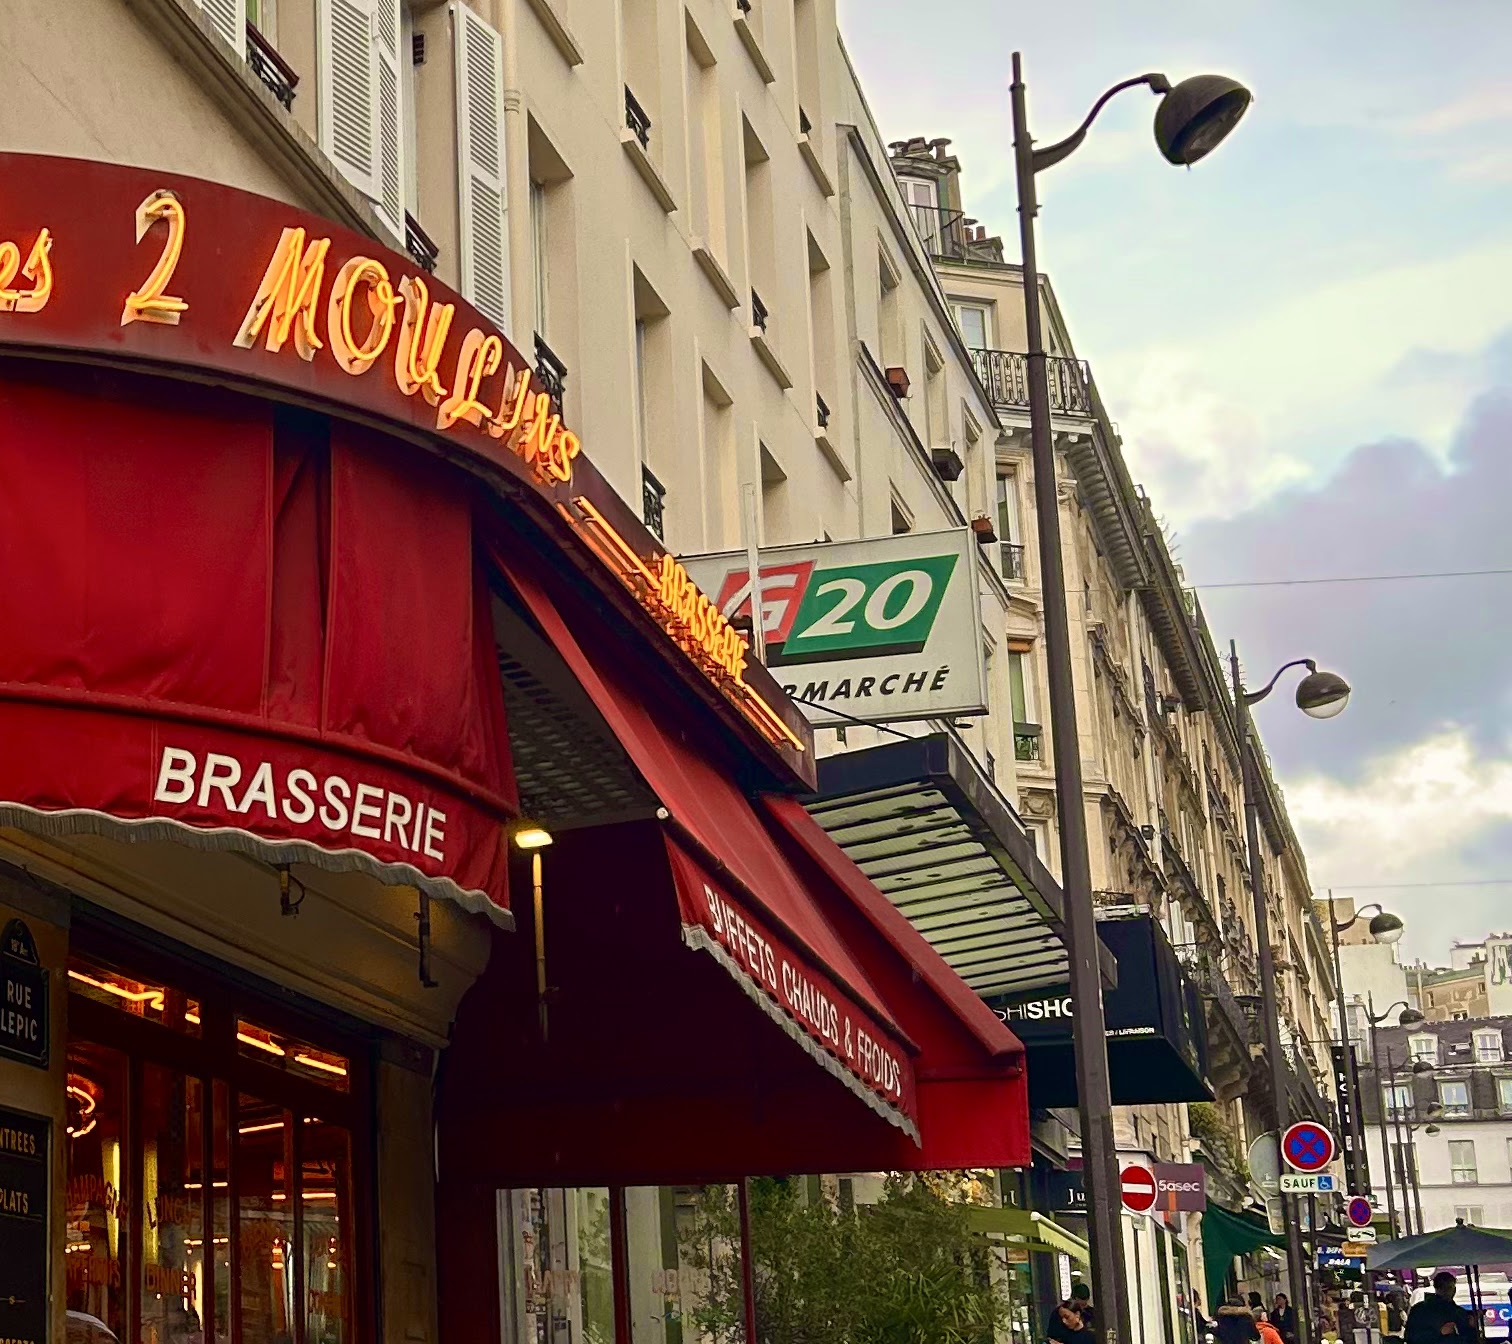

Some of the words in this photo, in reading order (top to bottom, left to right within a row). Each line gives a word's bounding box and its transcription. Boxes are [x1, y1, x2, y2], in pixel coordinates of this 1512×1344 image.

[121, 189, 189, 325] 2
[652, 553, 750, 688] BRASSERIE
[782, 666, 950, 704] RMARCHÉ
[153, 745, 447, 862] BRASSERIE
[7, 979, 32, 1009] RUE
[703, 883, 778, 990] BUFFETS
[782, 959, 839, 1046] CHAUDS
[844, 1015, 854, 1060] &
[857, 1027, 901, 1097] FROIDS
[0, 1008, 38, 1042] LEPIC
[993, 997, 1074, 1022] SHISHO
[1283, 1178, 1316, 1189] SAUF
